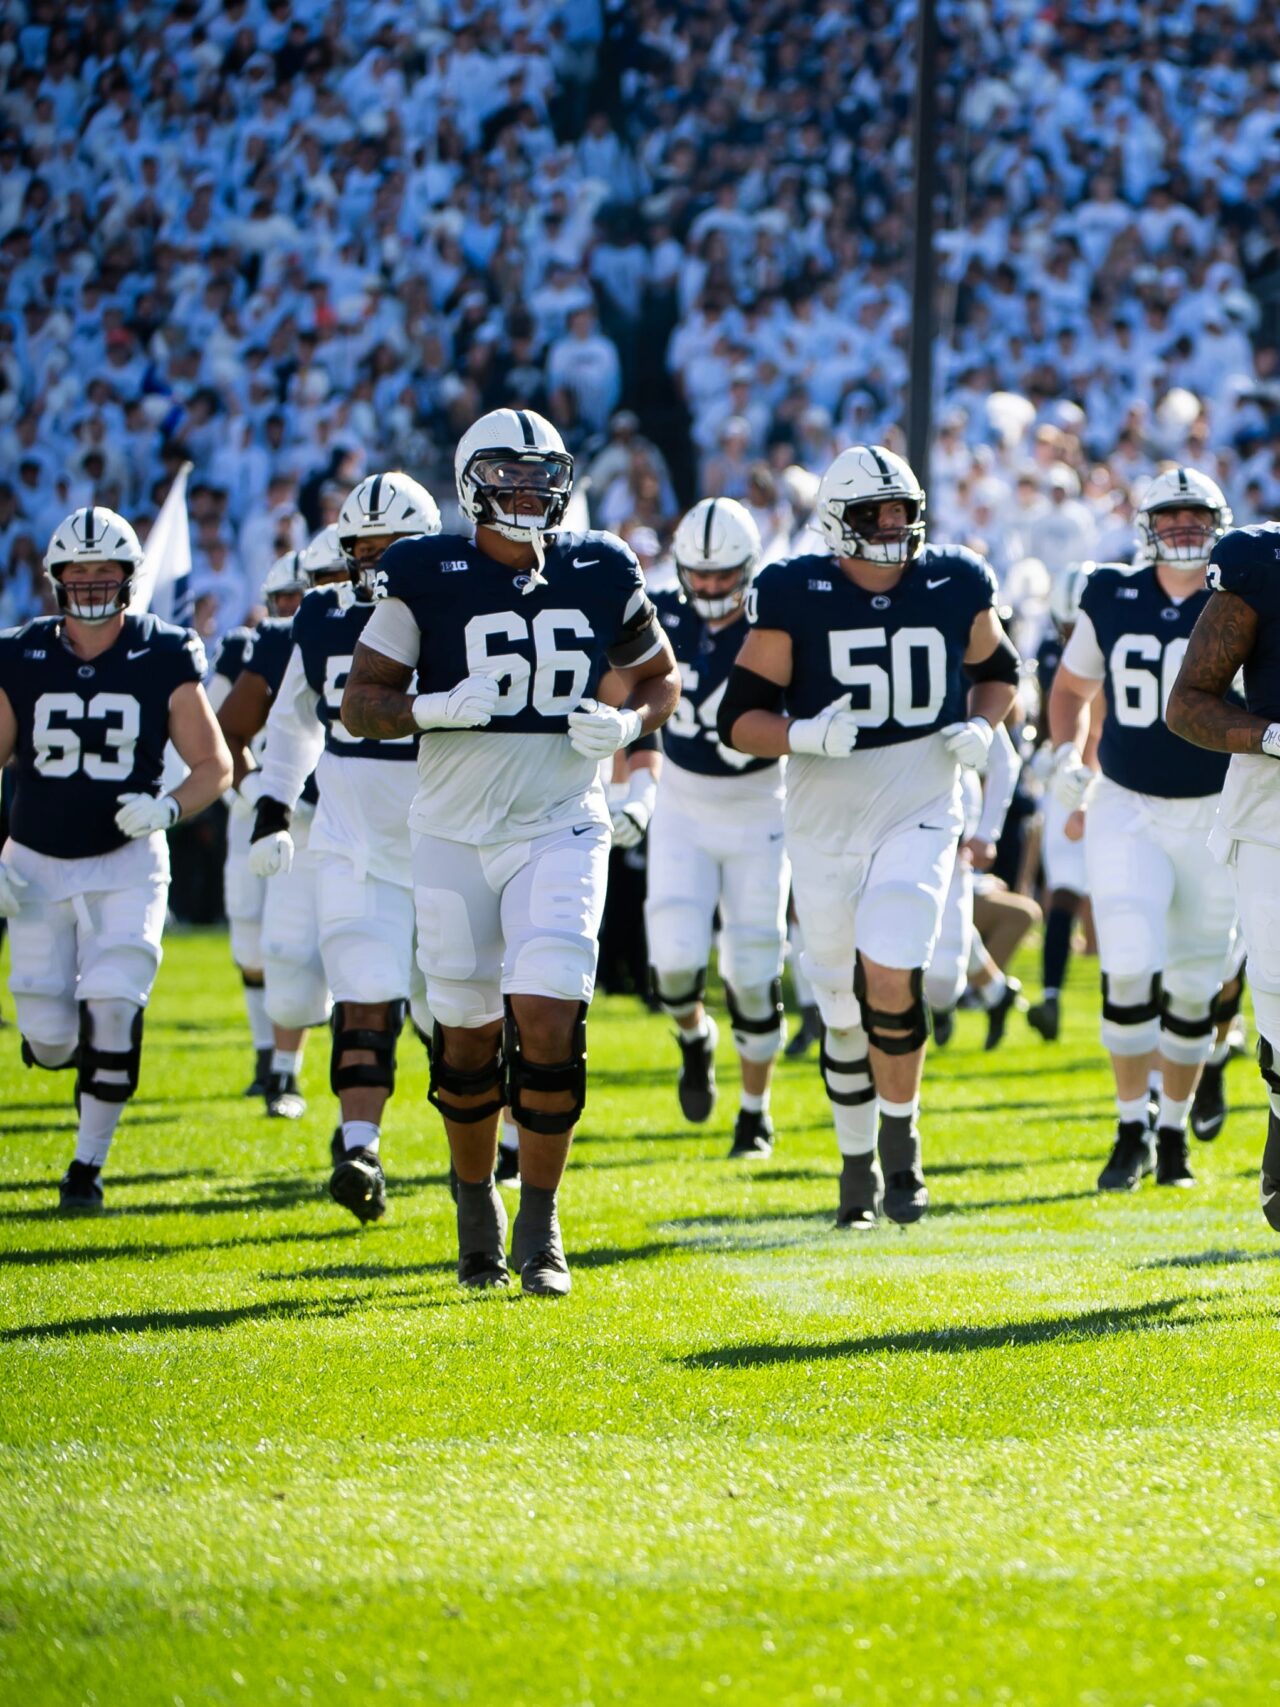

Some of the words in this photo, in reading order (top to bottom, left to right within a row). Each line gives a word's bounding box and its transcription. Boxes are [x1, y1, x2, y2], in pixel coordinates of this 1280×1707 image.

[464, 608, 595, 717] 66
[828, 627, 947, 729] 50
[32, 691, 141, 782] 63
